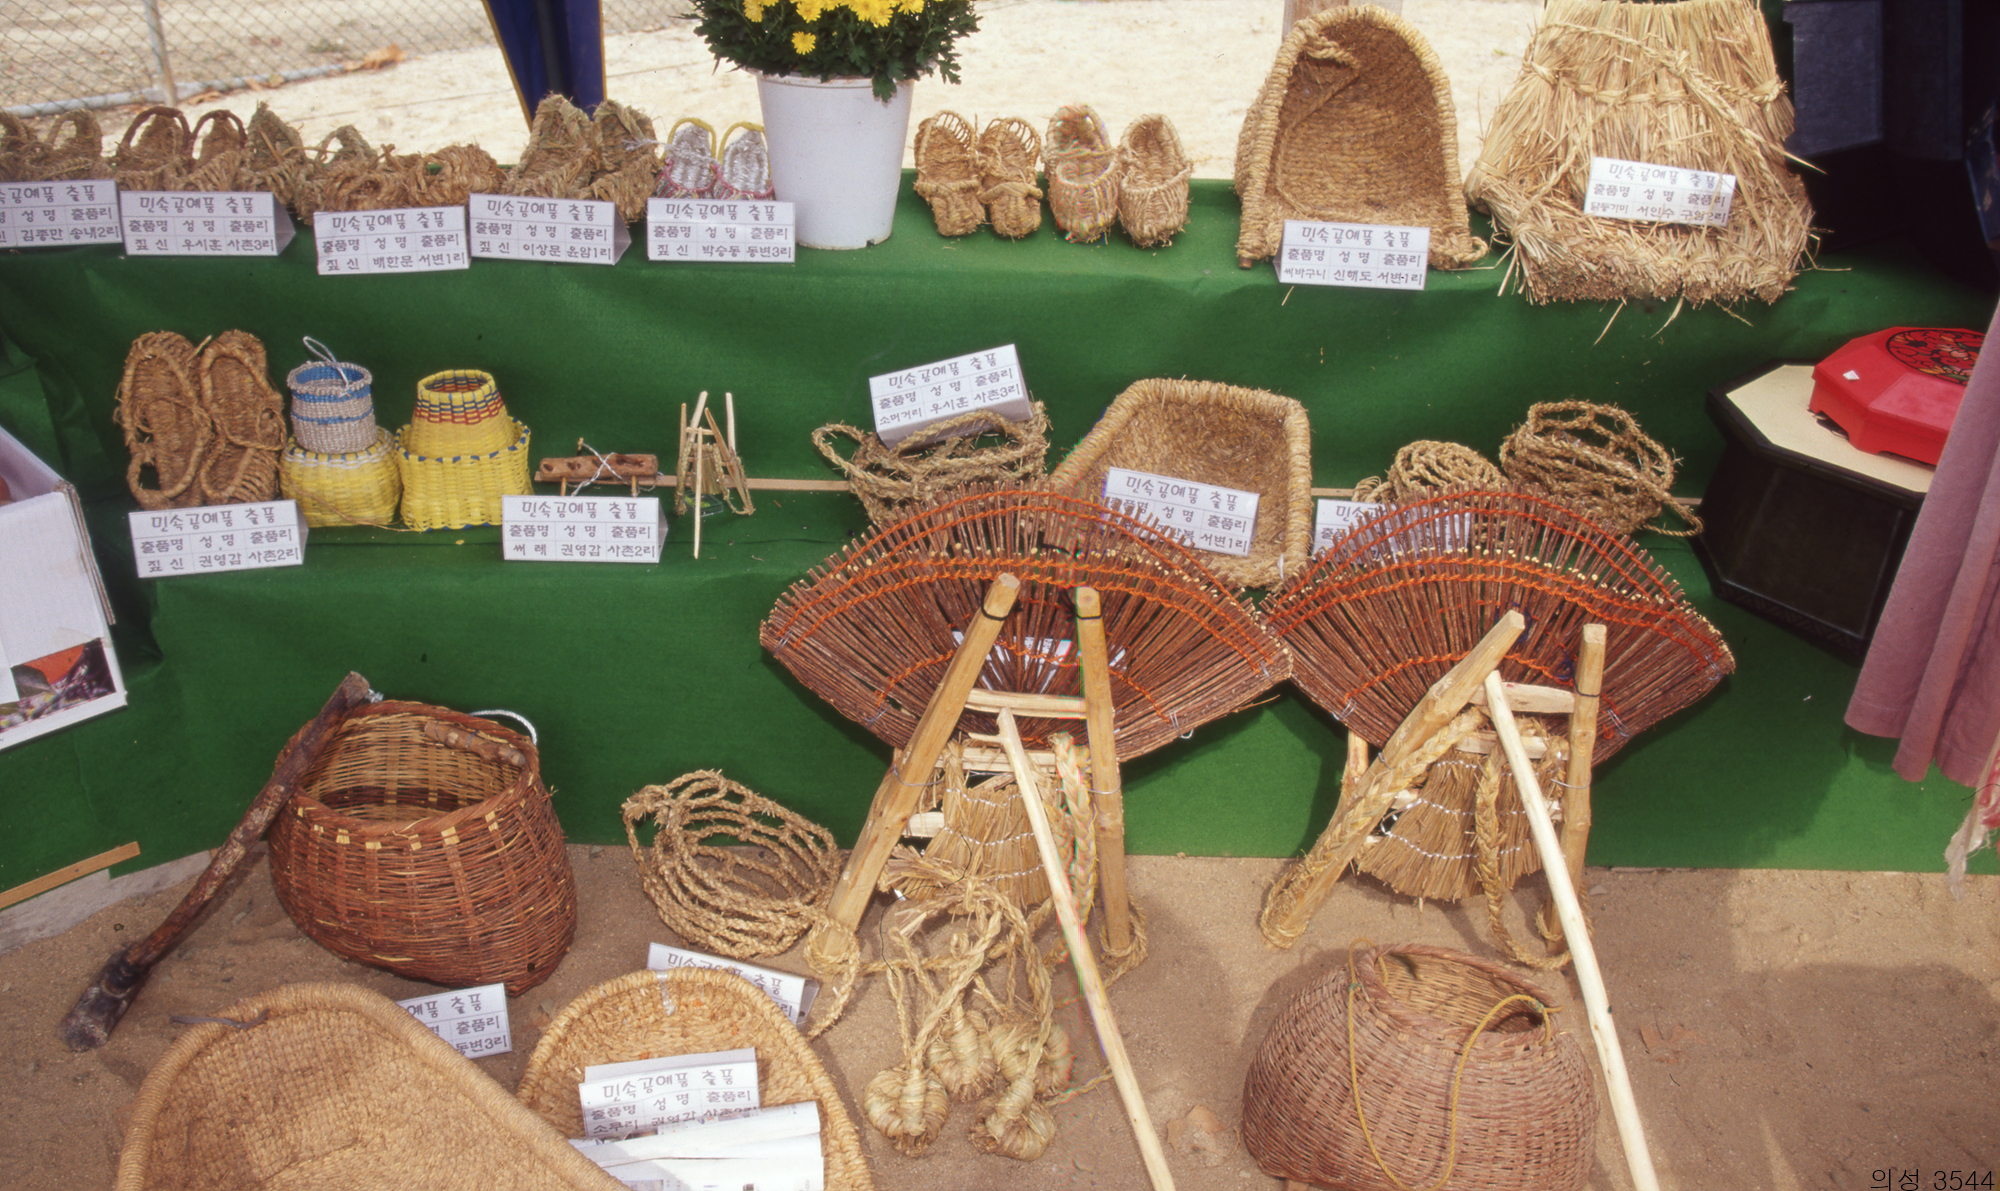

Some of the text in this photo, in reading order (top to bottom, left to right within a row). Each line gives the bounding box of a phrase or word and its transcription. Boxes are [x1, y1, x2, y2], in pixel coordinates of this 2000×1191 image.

[1593, 183, 1630, 198] 출품명
[71, 207, 112, 221] 출품리
[21, 228, 63, 241] 김종만
[70, 226, 119, 240] 송내2리
[129, 220, 168, 232] 출품명
[230, 220, 268, 233] 출품리
[475, 221, 512, 236] 출품명
[570, 227, 607, 241] 출품리
[653, 225, 691, 238] 출품명
[750, 227, 788, 240] 출품리
[182, 239, 222, 251] 우시훈
[227, 239, 274, 251] 사촌3리
[322, 238, 360, 253] 출품명
[420, 233, 459, 248] 출품리
[523, 243, 561, 257] 이상문
[567, 246, 611, 260] 윤암1리
[373, 255, 413, 269] 배한문
[419, 252, 465, 267] 서변1리
[702, 245, 740, 257] 박승동
[746, 246, 791, 259] 동변3리
[1287, 248, 1325, 262] 출품명
[1383, 253, 1421, 267] 출품리
[879, 391, 917, 410] 출품명
[975, 368, 1013, 387] 출품리
[929, 396, 969, 414] 우시훈
[974, 383, 1021, 403] 사촌3리
[509, 525, 549, 538] 출품명
[611, 526, 651, 539] 출품리
[1207, 514, 1247, 533] 출품리
[140, 538, 183, 554] 출품명
[250, 528, 292, 545] 출품리
[1200, 534, 1247, 553] 서변1리
[199, 553, 242, 568] 권영갑
[248, 547, 299, 563] 사촌2리
[561, 544, 601, 556] 권영갑
[607, 545, 655, 558] 사촌2리
[456, 1015, 500, 1035] 출품리
[591, 1104, 636, 1121] 출품명
[706, 1090, 751, 1103] 출품리
[593, 1119, 639, 1135] 소쿠리
